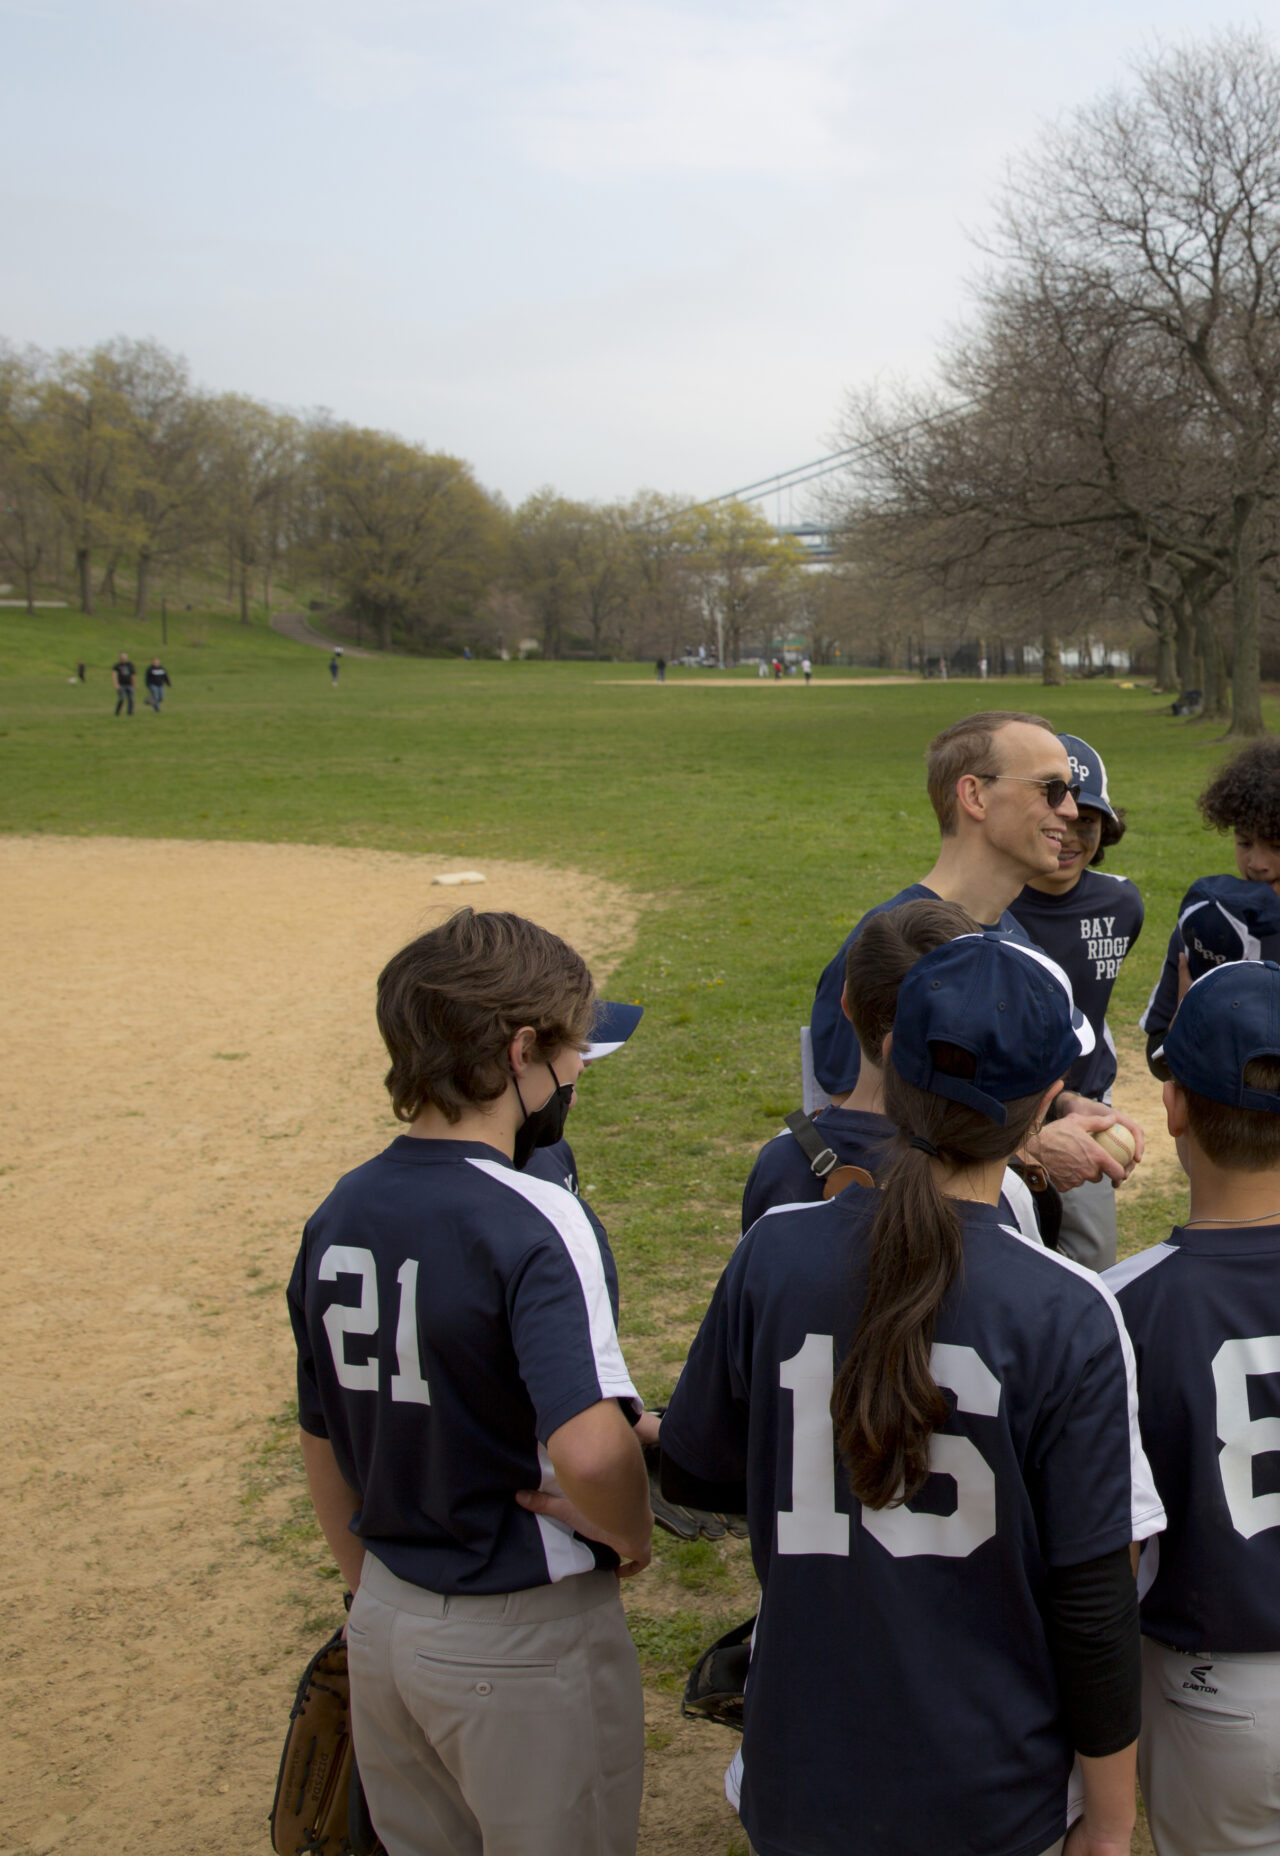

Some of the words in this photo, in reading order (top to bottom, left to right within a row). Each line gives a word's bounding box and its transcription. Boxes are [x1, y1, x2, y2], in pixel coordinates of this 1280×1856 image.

[1068, 756, 1090, 782] RP
[1080, 916, 1116, 939] BAY
[1095, 957, 1124, 980] PR
[317, 1245, 431, 1406] 21
[777, 1334, 1001, 1557] 16
[1182, 1681, 1218, 1695] EASTON
